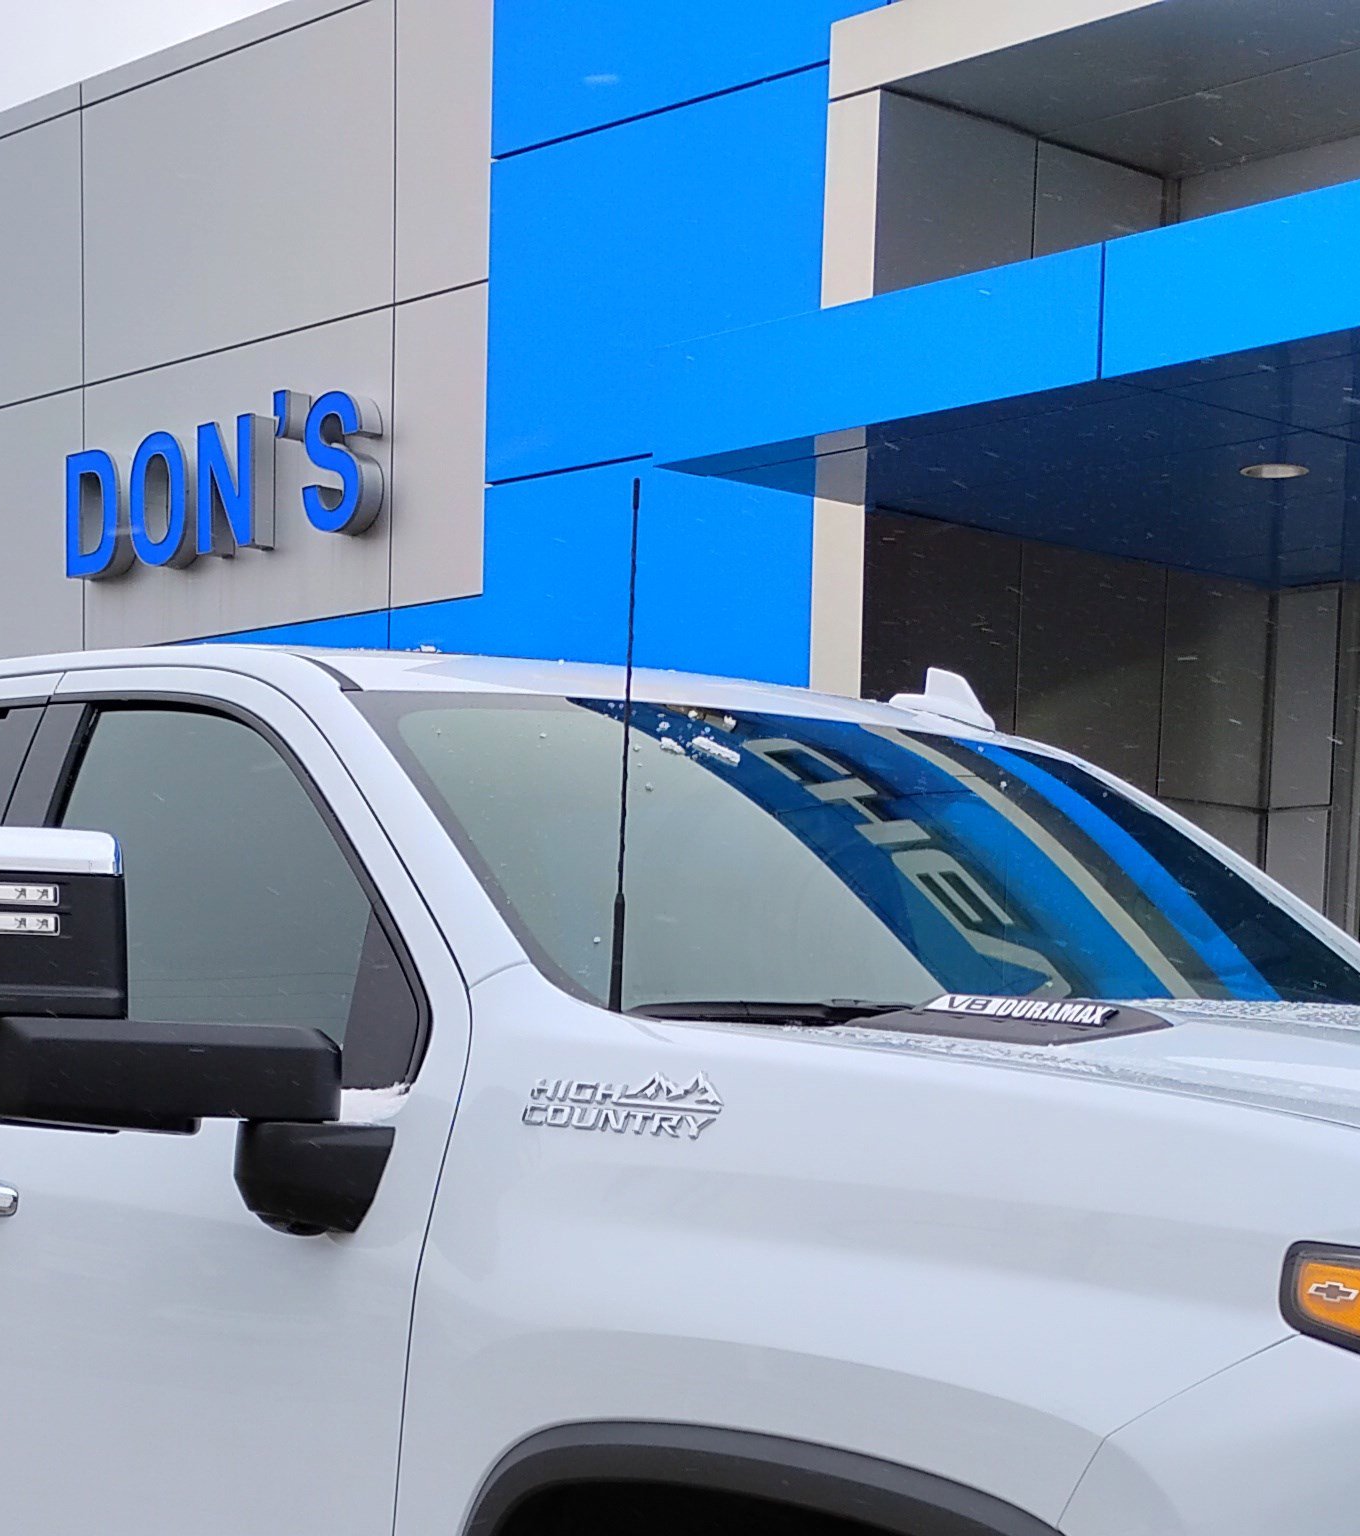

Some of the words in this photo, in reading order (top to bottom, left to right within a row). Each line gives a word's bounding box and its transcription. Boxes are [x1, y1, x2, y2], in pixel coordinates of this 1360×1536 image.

[65, 389, 383, 580] DON'S
[996, 998, 1108, 1027] DURAMAX
[529, 1078, 628, 1105] HIGH
[521, 1103, 717, 1140] COUNTRY
